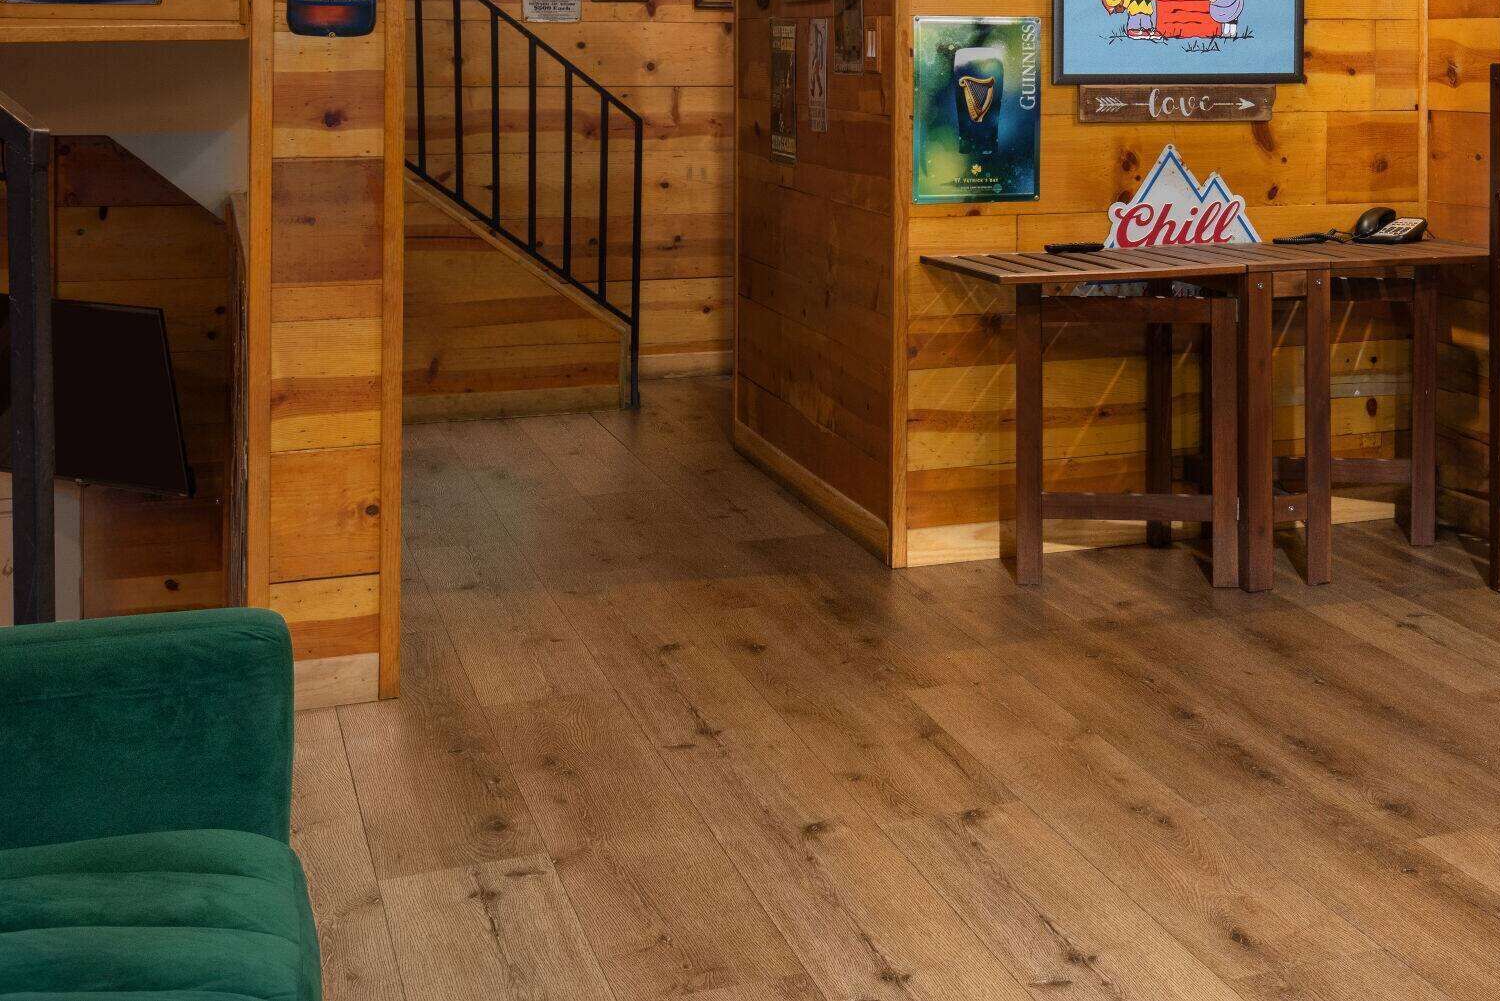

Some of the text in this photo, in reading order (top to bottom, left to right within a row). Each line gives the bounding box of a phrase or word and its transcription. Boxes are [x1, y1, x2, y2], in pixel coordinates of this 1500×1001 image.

[1019, 24, 1036, 110] GUINNESS
[1149, 88, 1215, 118] love
[1114, 200, 1240, 249] Chill
